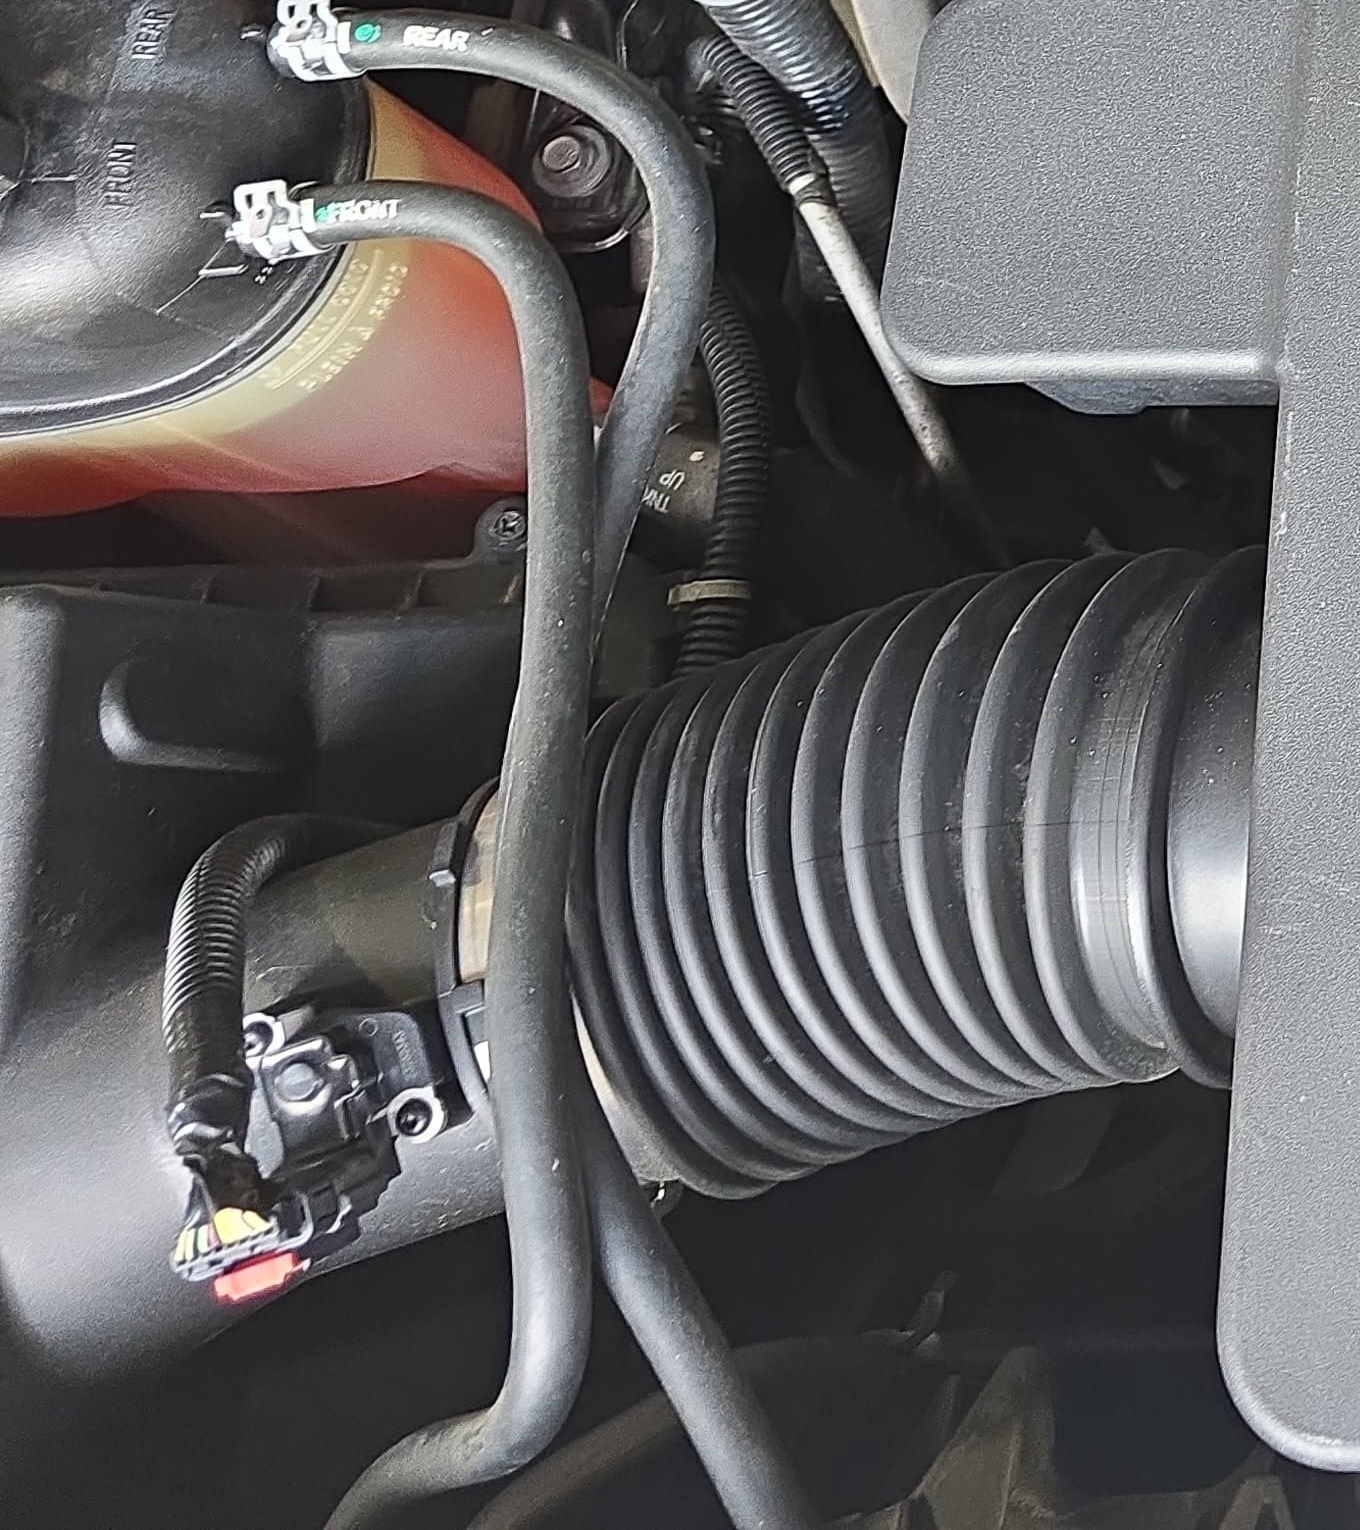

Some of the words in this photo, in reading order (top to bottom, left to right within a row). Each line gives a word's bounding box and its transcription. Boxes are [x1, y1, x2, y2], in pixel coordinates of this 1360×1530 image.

[132, 9, 177, 60] REAR
[402, 24, 471, 52] REAR
[101, 141, 137, 208] FRONT
[331, 198, 402, 223] FRONT
[658, 469, 686, 491] UP
